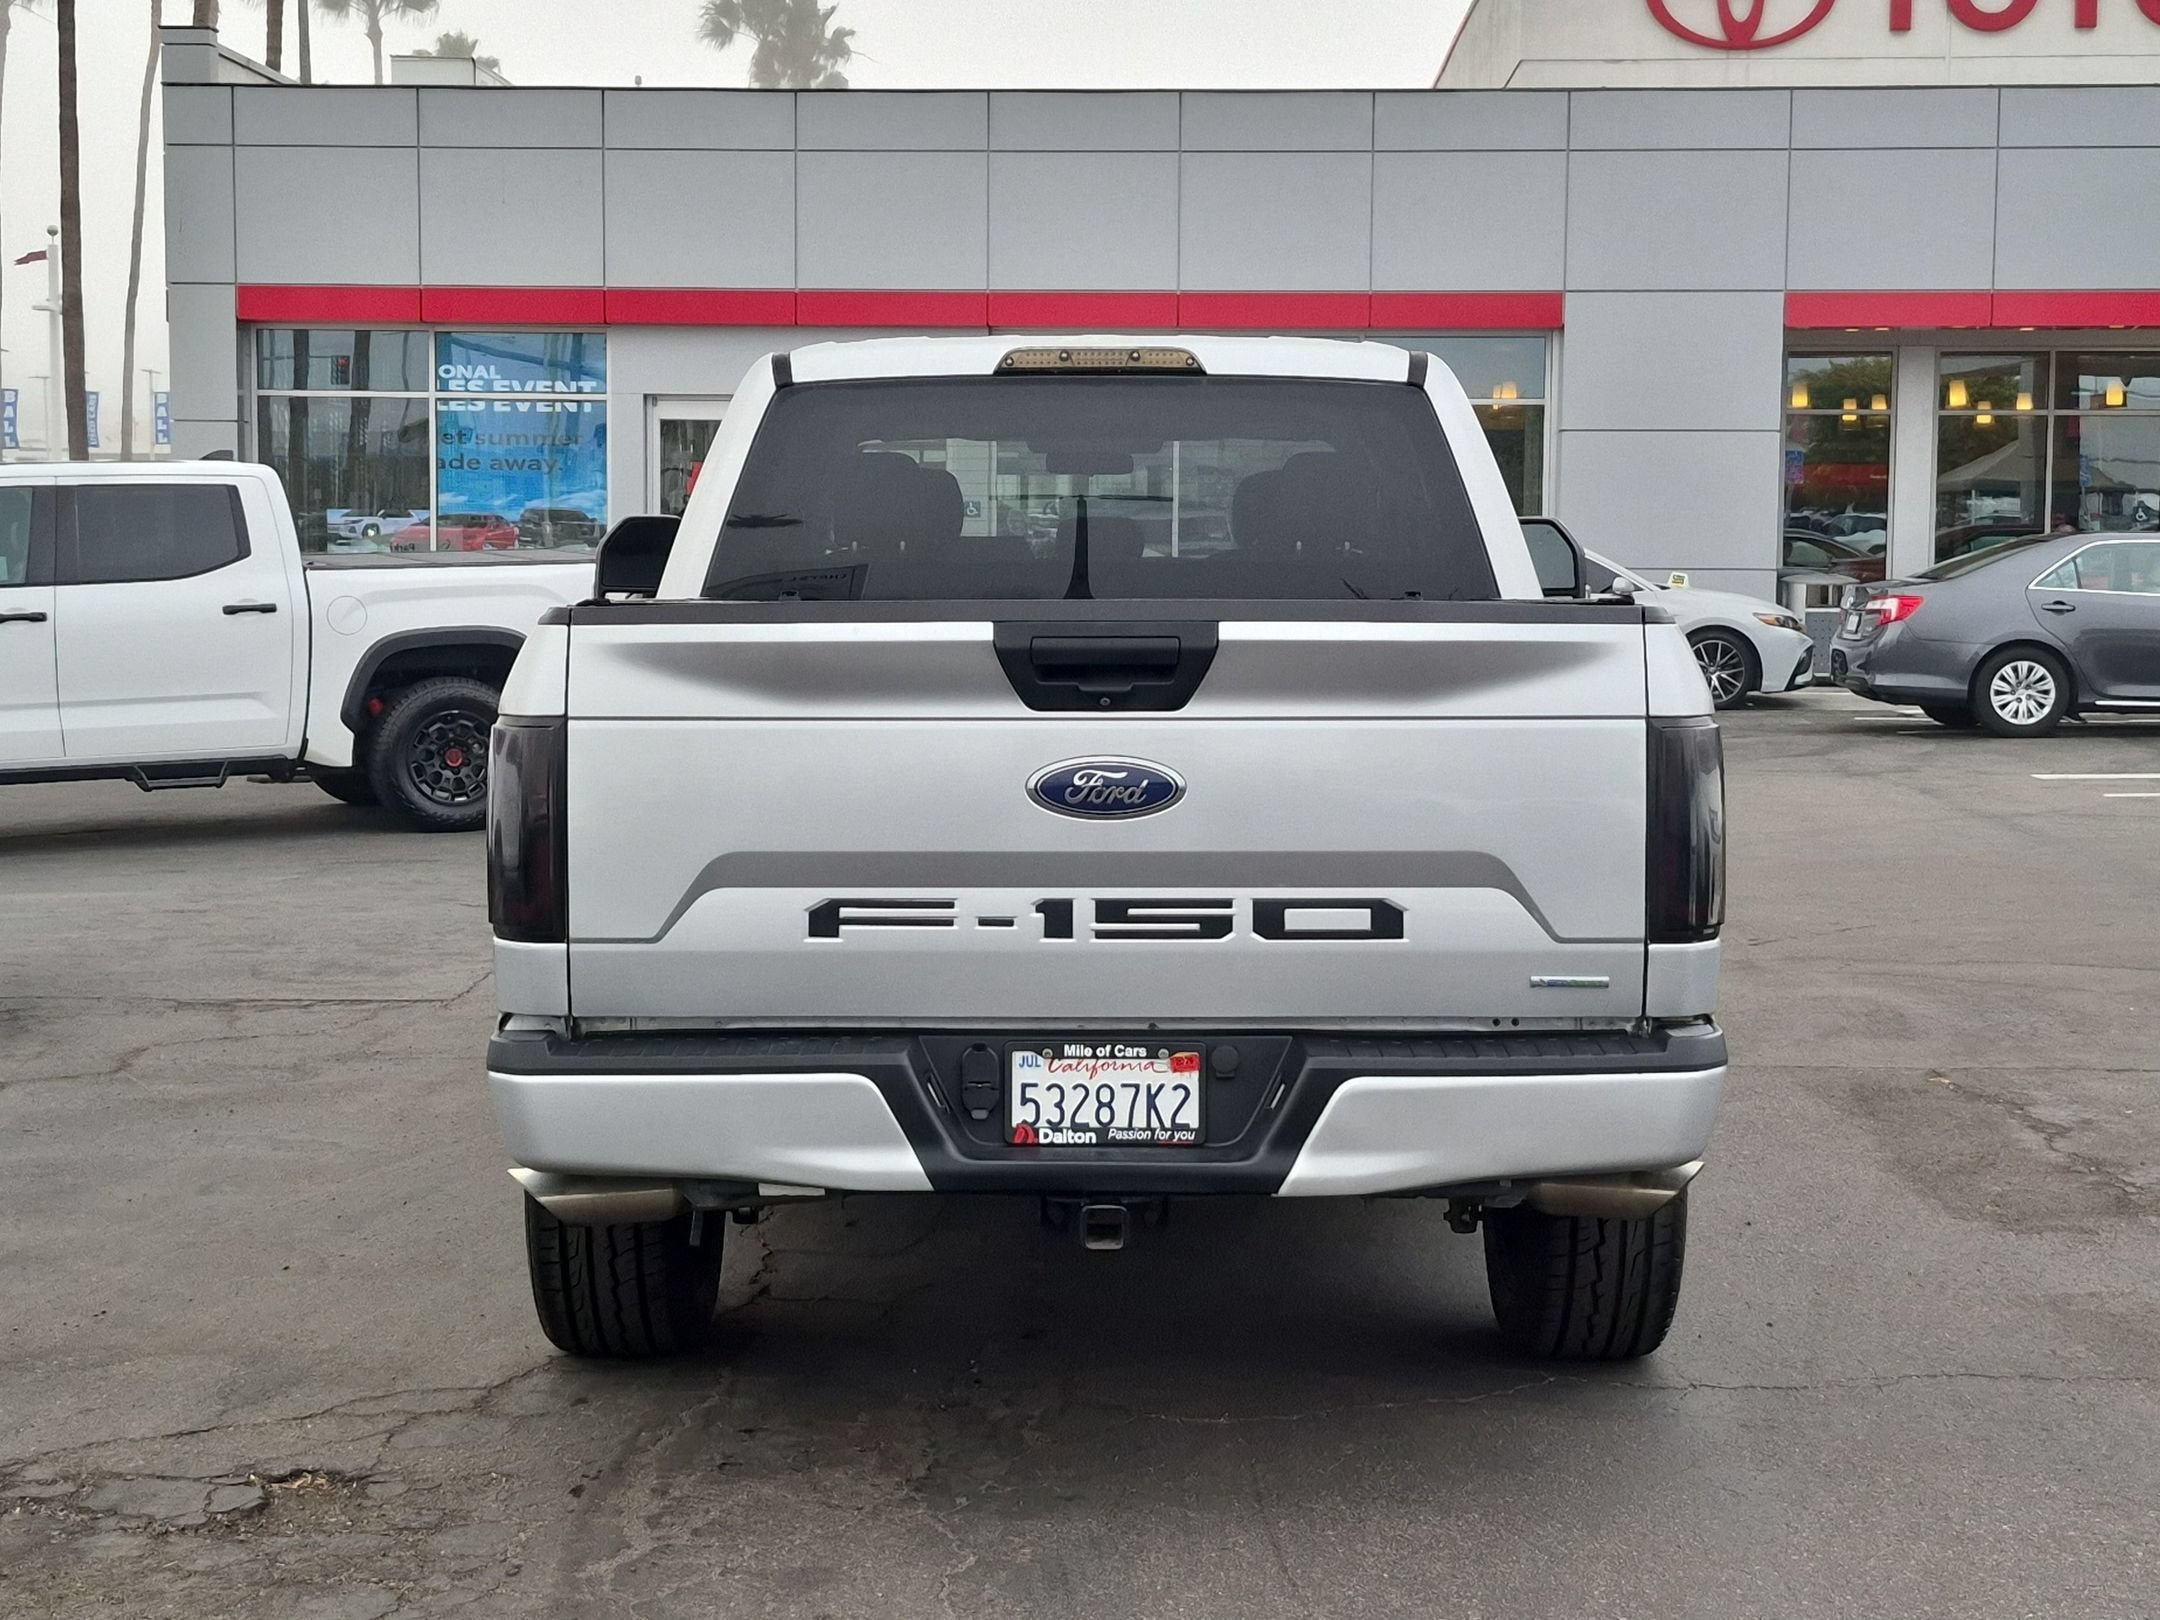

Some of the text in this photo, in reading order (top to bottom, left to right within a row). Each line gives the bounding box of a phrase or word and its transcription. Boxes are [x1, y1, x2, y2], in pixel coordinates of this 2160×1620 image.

[438, 364, 502, 379] ONAL
[492, 380, 597, 412] EVENT
[3, 390, 17, 448] BALL
[475, 431, 584, 446] summer
[489, 457, 564, 475] away.
[1064, 769, 1149, 804] Ford
[803, 897, 1409, 943] F-150
[1063, 1044, 1148, 1058] Mile of Cars
[1018, 1055, 1041, 1068] JUL
[1047, 1058, 1170, 1080] California
[1020, 1082, 1192, 1128] 53287K2
[1038, 1128, 1097, 1144] Dalton
[1107, 1128, 1196, 1142] Passion for you
